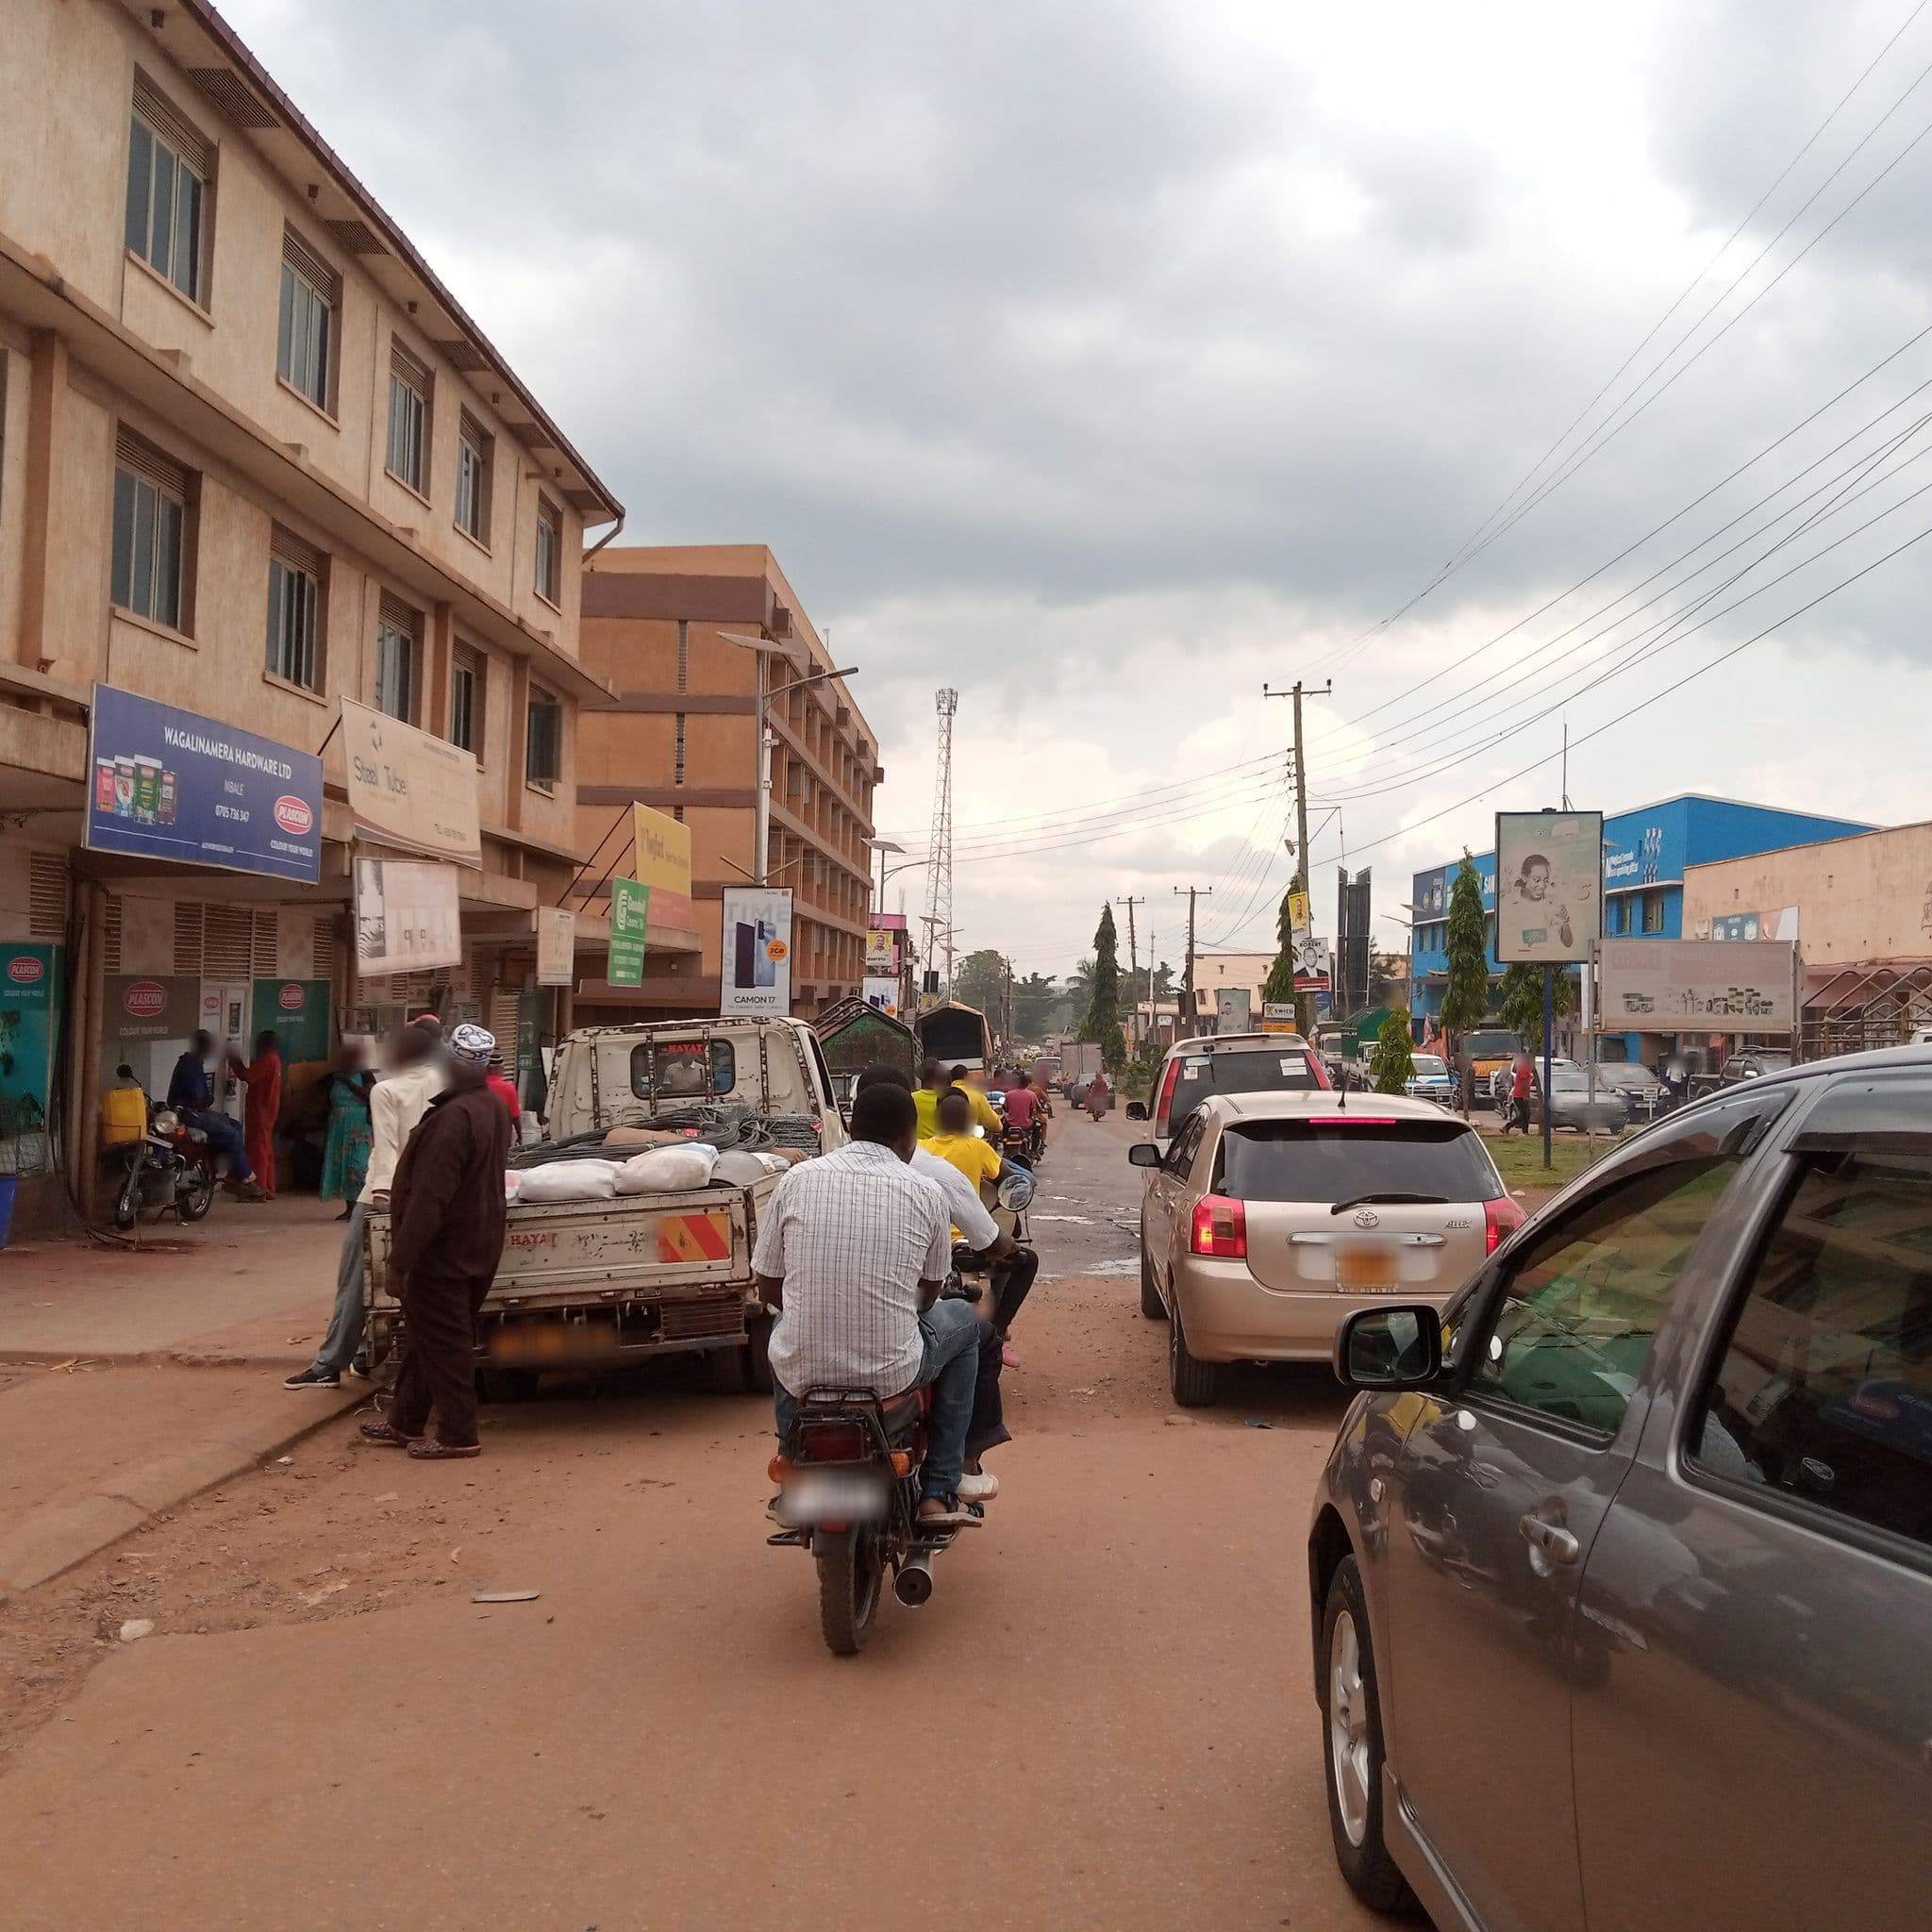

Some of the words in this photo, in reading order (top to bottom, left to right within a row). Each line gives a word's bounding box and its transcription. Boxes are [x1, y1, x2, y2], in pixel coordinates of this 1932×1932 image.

[164, 725, 235, 762] WAGALINAMERA
[235, 749, 278, 775] HARDWARE
[278, 761, 291, 780] LTD
[225, 779, 244, 797] MBALE
[279, 805, 308, 825] PLASCON
[10, 964, 41, 975] PLASCON
[127, 991, 164, 1007] PLASCON
[734, 995, 767, 1005] CAMON
